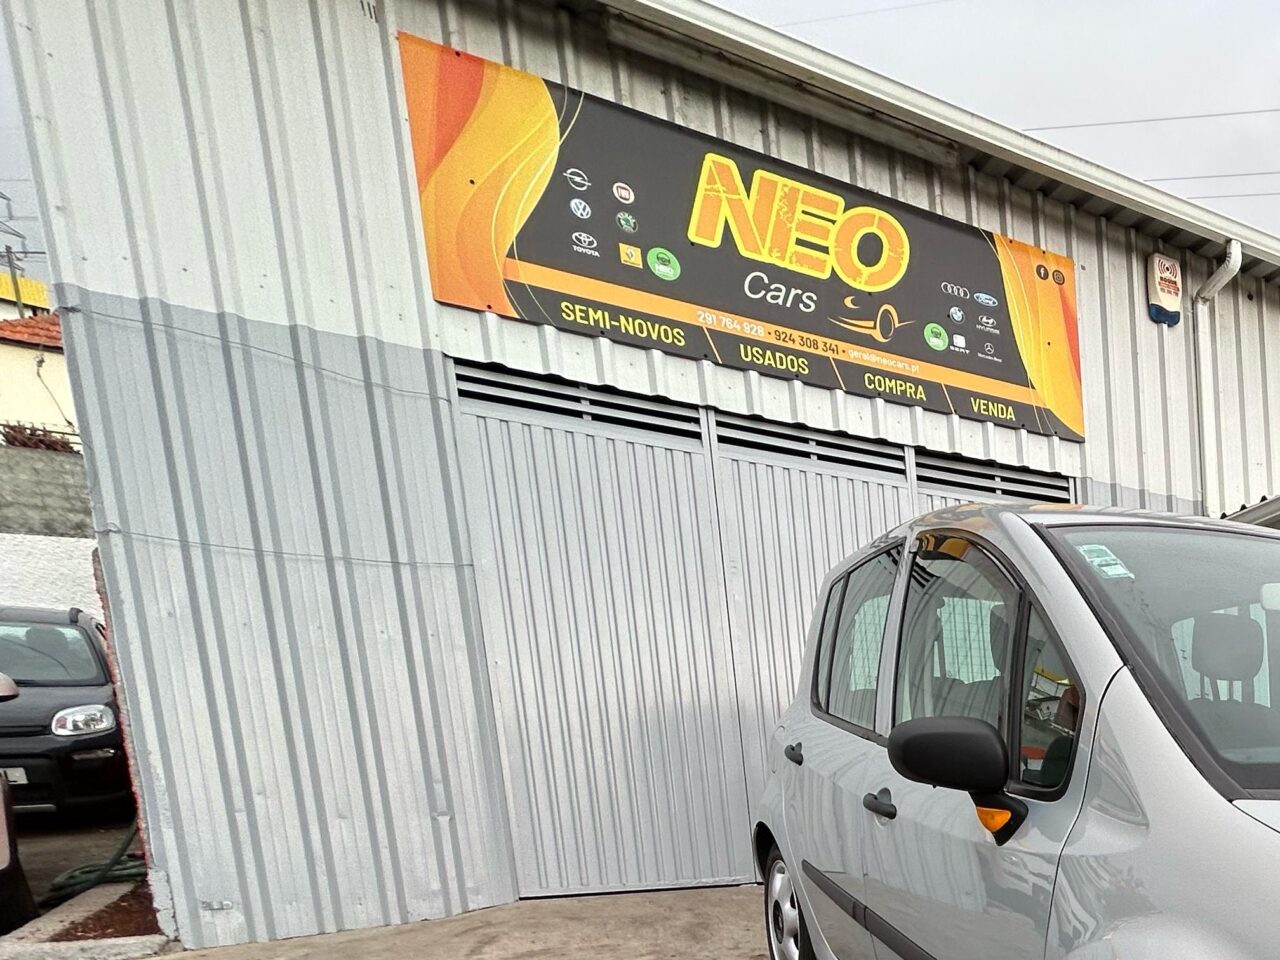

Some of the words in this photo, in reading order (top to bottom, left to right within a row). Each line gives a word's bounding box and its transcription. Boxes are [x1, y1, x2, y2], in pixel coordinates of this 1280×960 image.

[688, 152, 910, 292] NEO
[572, 245, 600, 257] TOYOTA
[743, 271, 817, 312] Cars
[560, 301, 686, 346] SEMI-NOVOS
[697, 310, 717, 326] 291
[719, 316, 741, 331] 764
[774, 330, 796, 345] 924
[798, 335, 819, 350] 308
[821, 341, 839, 355] 341
[740, 343, 809, 375] USADOS
[864, 372, 927, 401] COMPRA
[971, 397, 1016, 421] VENDA
